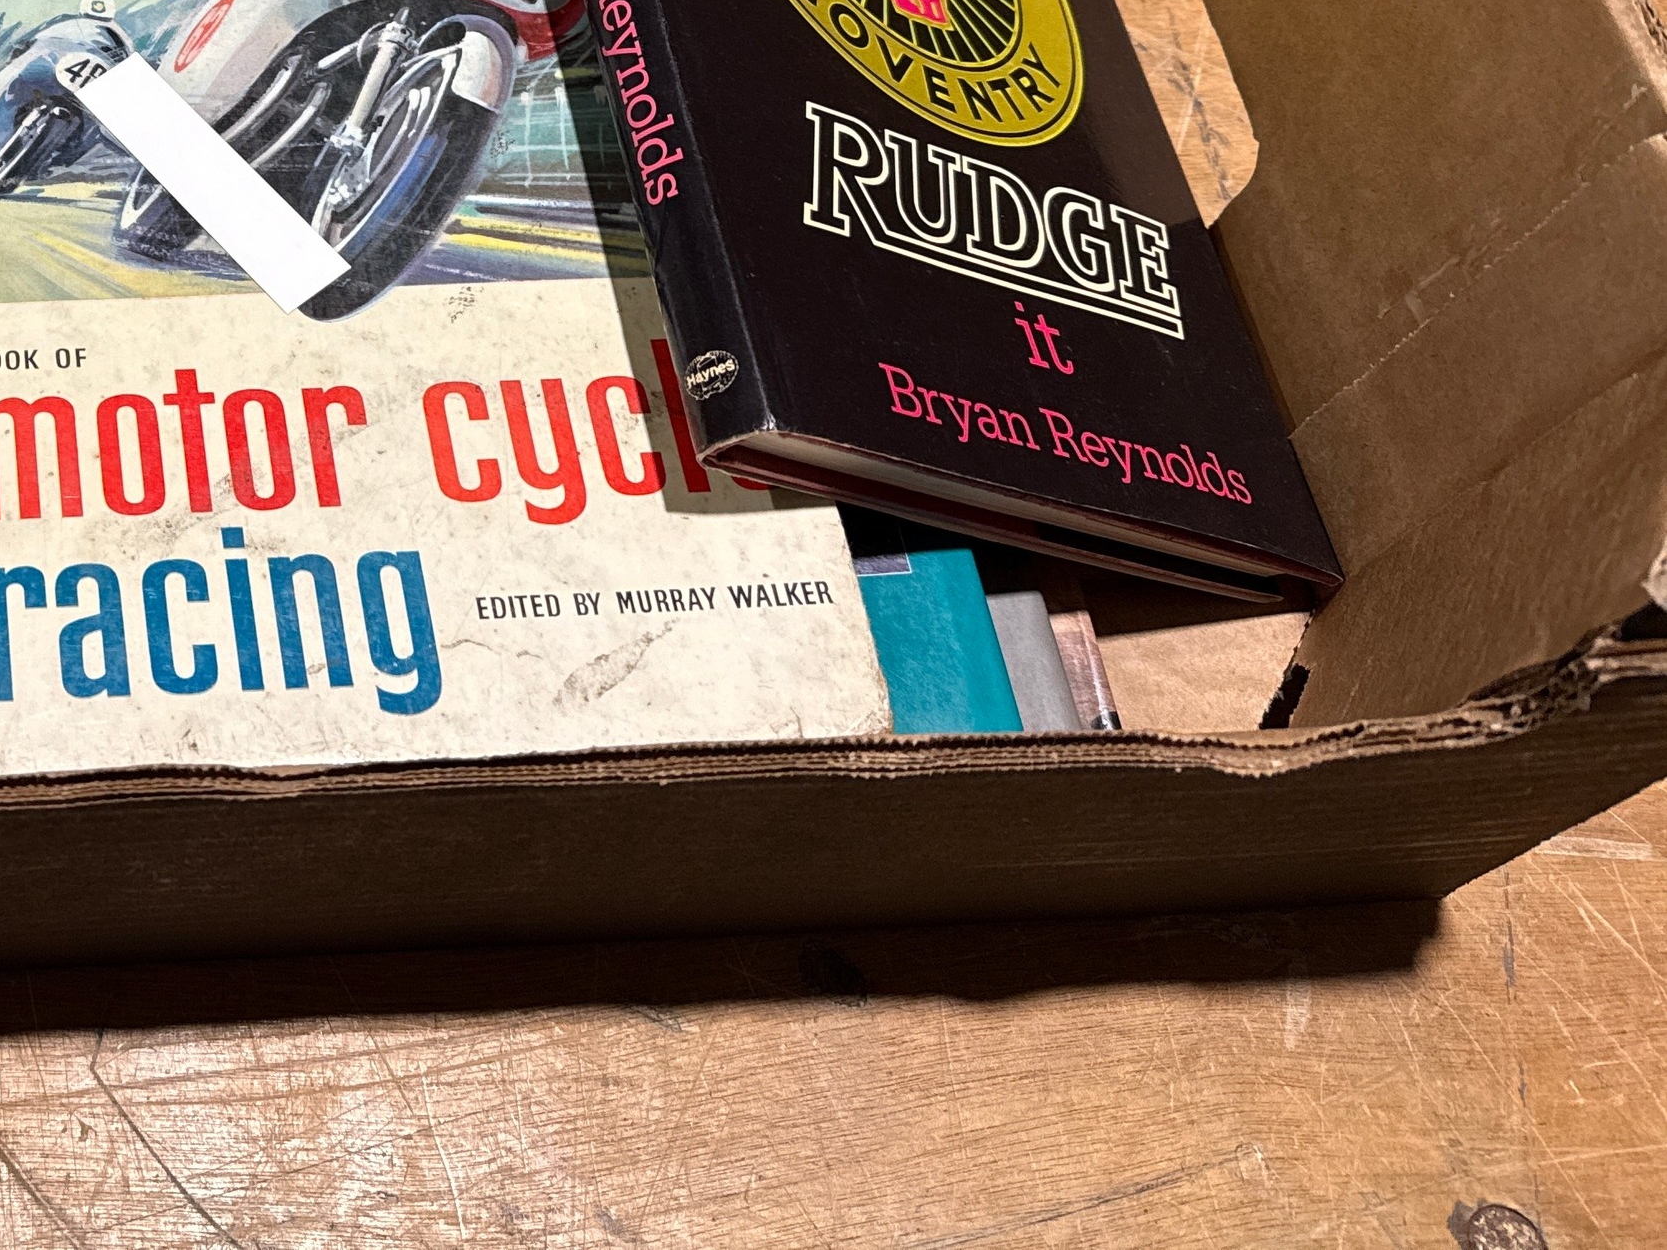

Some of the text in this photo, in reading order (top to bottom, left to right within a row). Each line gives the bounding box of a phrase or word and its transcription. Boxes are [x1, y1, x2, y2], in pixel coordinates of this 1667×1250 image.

[803, 100, 1185, 340] RUDGE
[54, 347, 87, 369] OF
[686, 359, 735, 389] Haynes
[1014, 301, 1074, 376] it
[424, 337, 772, 525] cycl
[878, 361, 1253, 506] Bryan Reynolds
[476, 579, 833, 621] EDITED BY MURRAY WALKER
